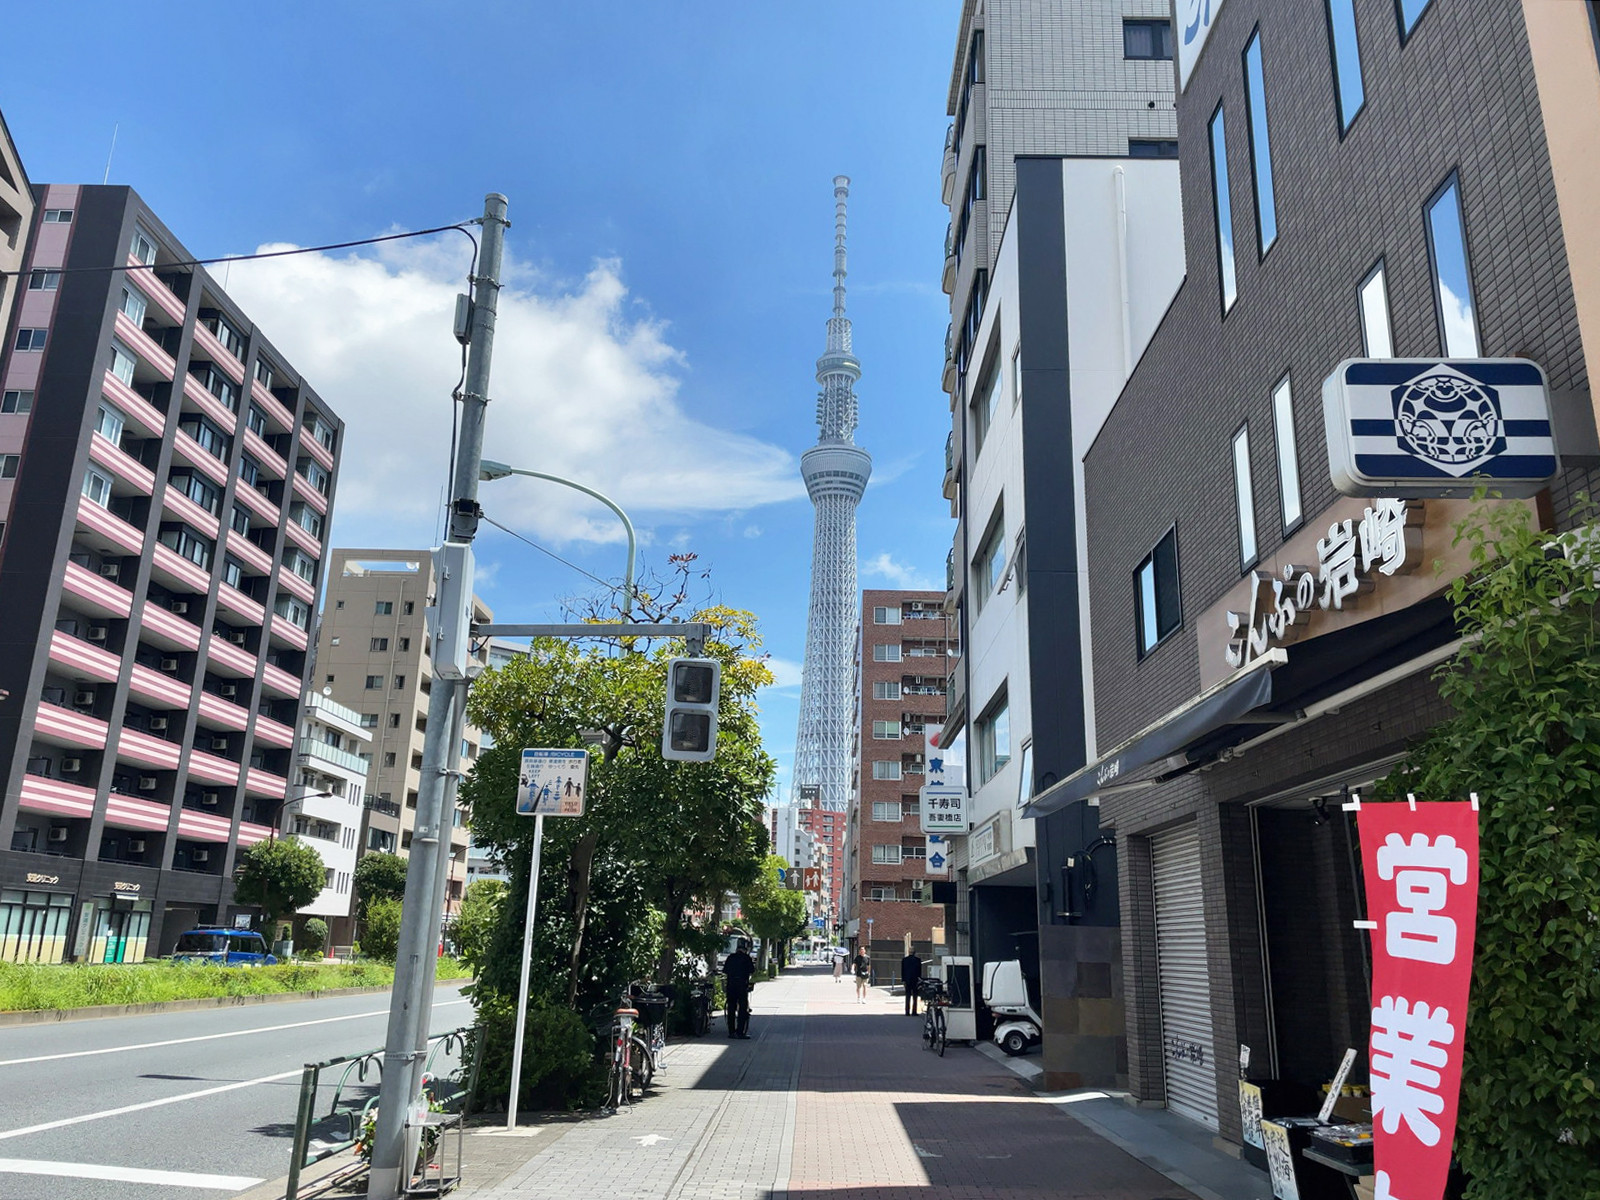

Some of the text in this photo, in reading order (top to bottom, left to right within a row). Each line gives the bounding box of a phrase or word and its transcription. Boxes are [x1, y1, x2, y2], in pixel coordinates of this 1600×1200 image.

[927, 797, 961, 810] 千寿司
[928, 813, 962, 823] 吾妻橋店
[1371, 832, 1468, 1200] 営業
